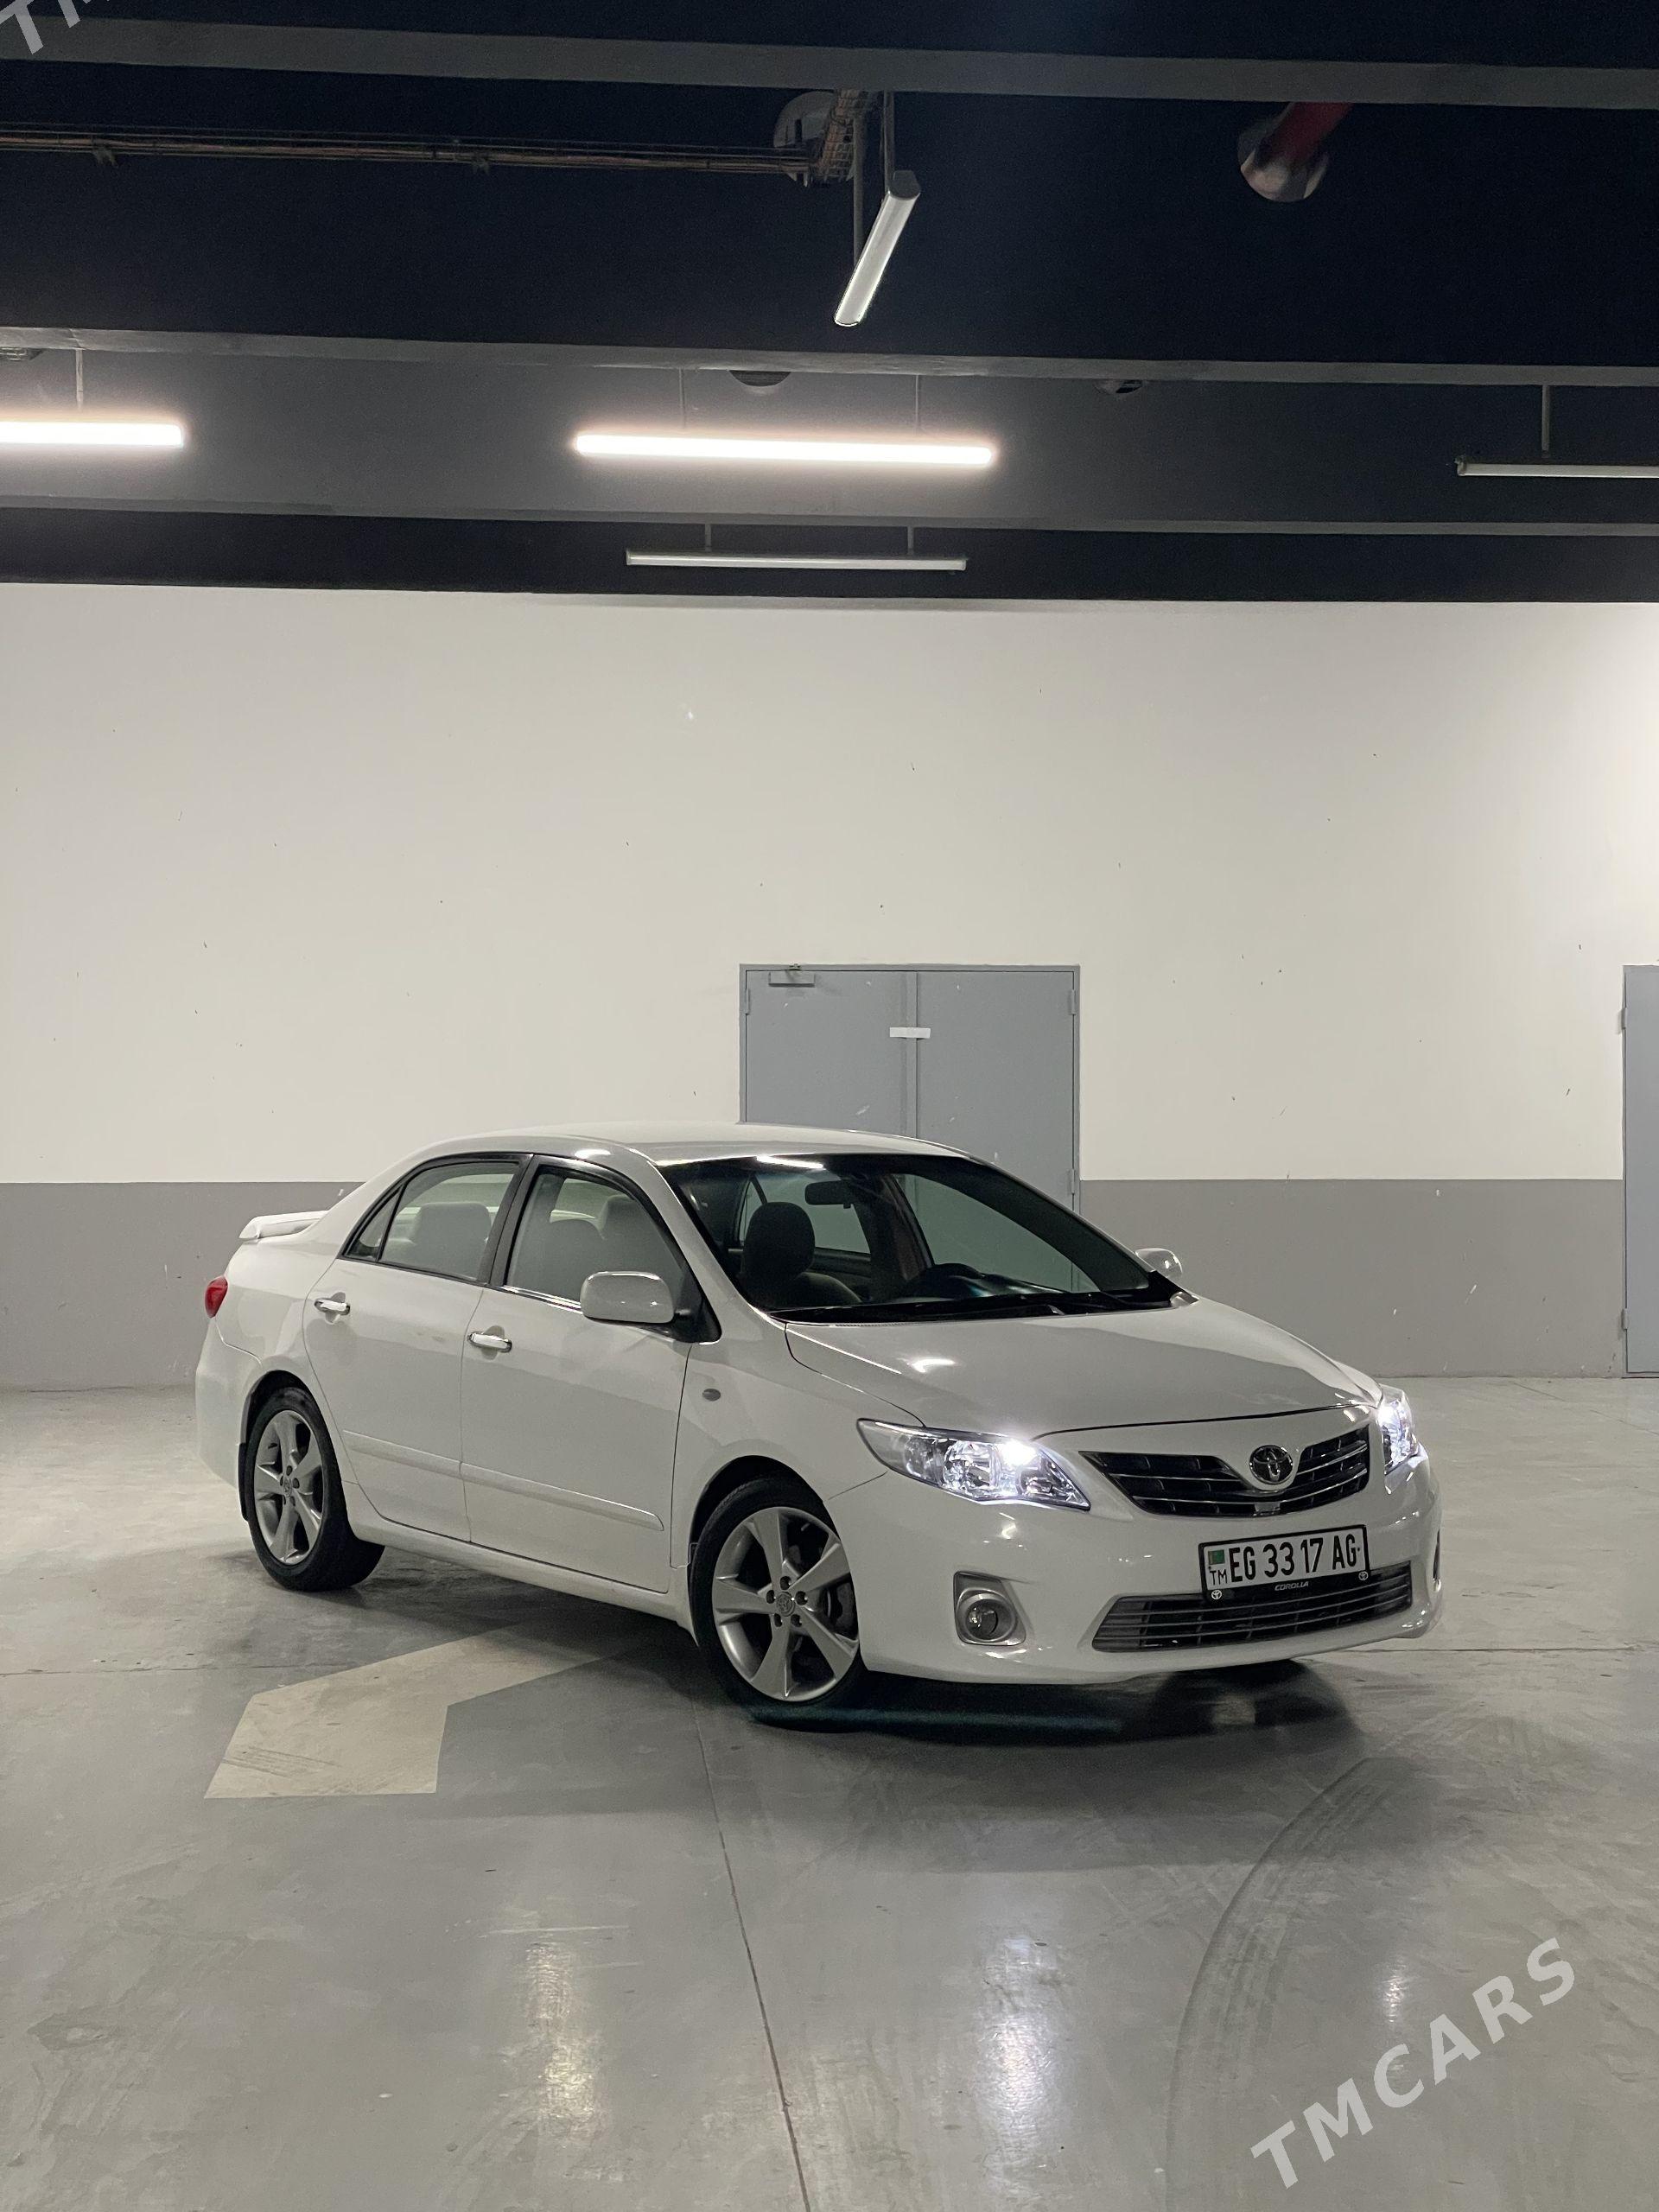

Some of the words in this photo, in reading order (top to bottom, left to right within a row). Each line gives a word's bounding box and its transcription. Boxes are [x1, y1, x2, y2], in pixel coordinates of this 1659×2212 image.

[1229, 1545, 1256, 1583] EG
[1332, 1534, 1357, 1570] AG
[1209, 1568, 1228, 1586] TM
[1274, 1580, 1309, 1592] COROLLA
